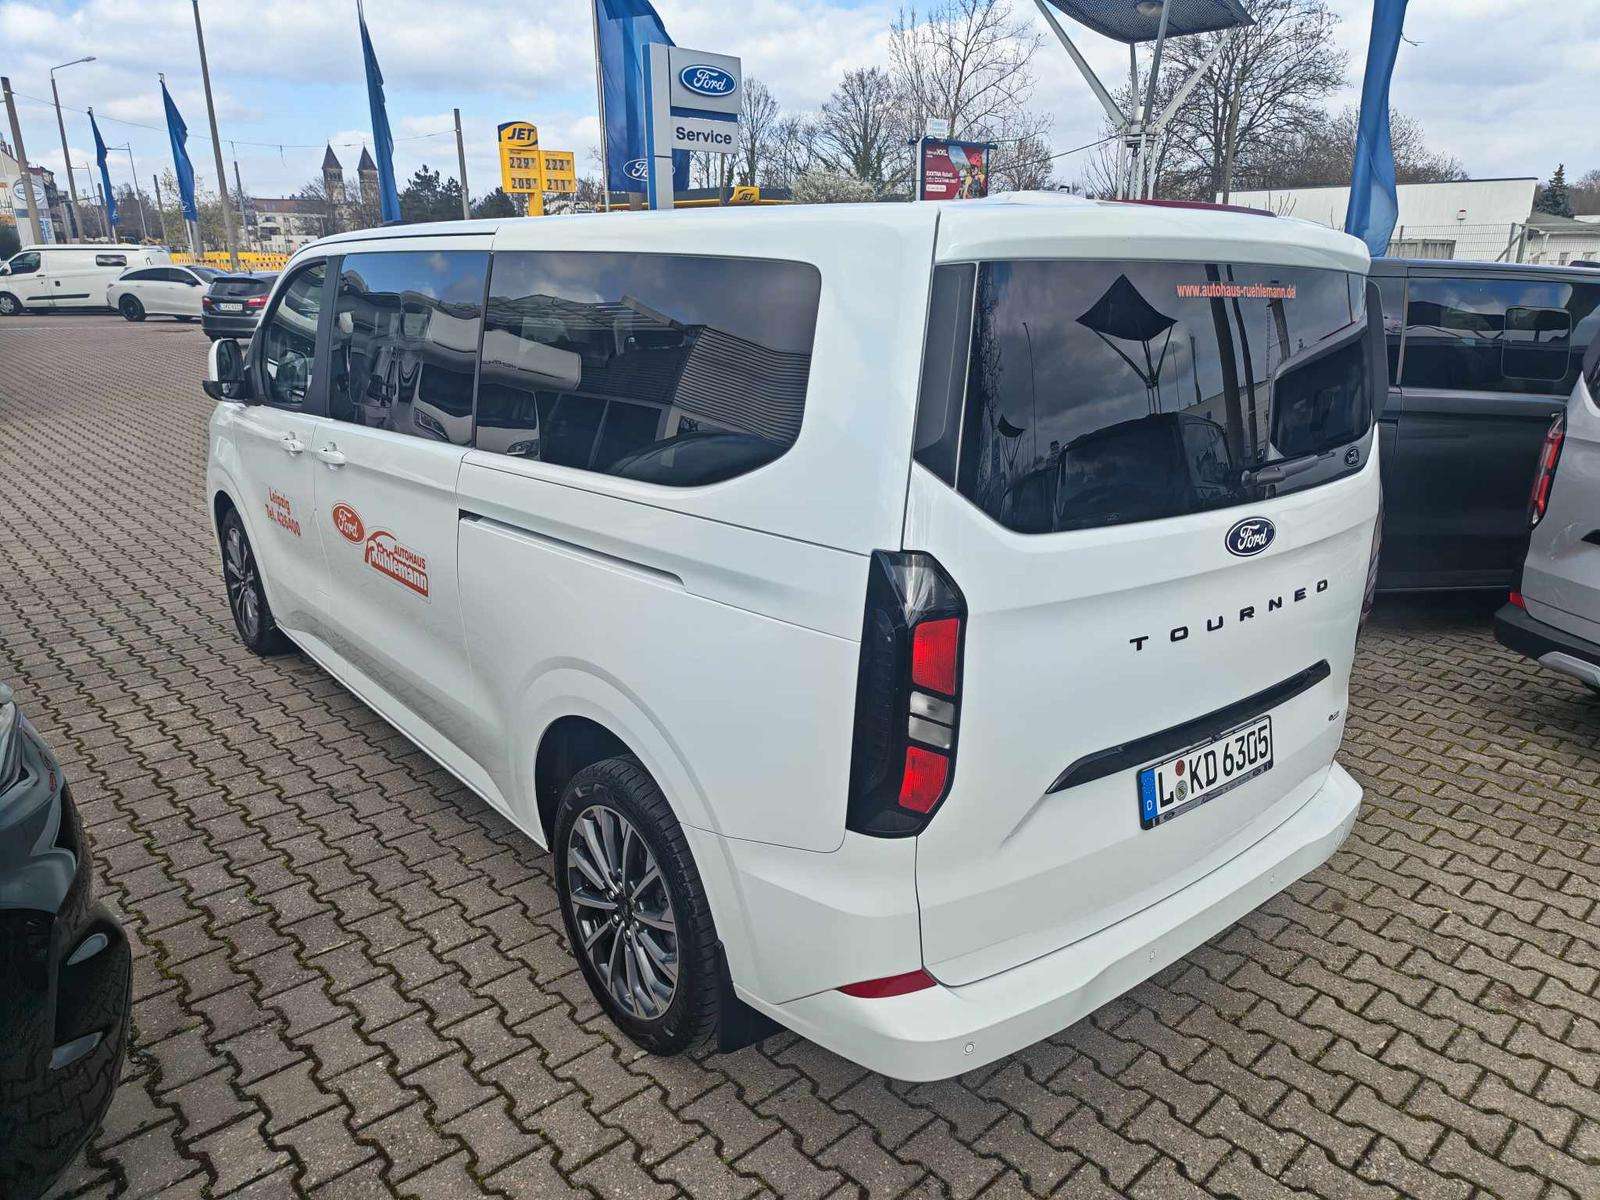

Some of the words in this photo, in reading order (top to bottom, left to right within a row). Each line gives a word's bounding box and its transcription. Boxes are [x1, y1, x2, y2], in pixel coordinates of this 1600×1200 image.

[693, 68, 726, 91] Ford
[507, 127, 535, 141] JET
[675, 126, 732, 145] Service
[739, 193, 755, 201] JET
[1176, 282, 1297, 299] www.autohaus-ruehlemann.de
[268, 487, 291, 515] Leipzig
[337, 508, 360, 539] Ford
[1237, 525, 1268, 550] Ford
[366, 538, 428, 592] Rühlemann
[393, 545, 426, 570] AUTOHAUS
[1129, 579, 1329, 651] TOURNEO
[1157, 771, 1175, 808] L
[1188, 749, 1218, 794] KD
[1222, 724, 1270, 777] 6305
